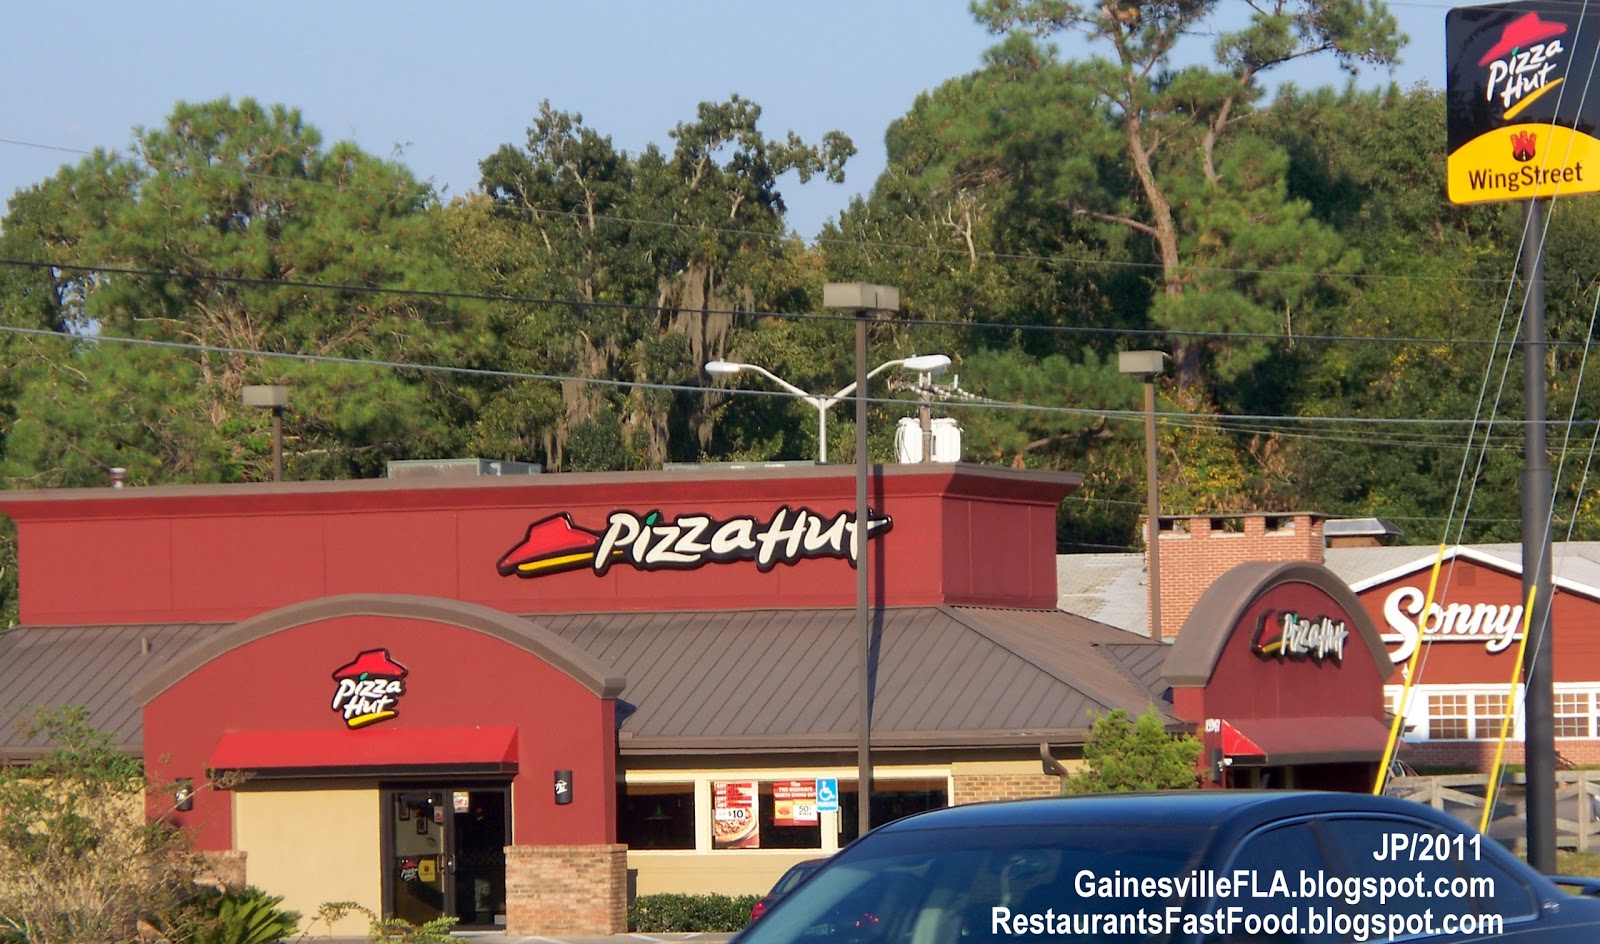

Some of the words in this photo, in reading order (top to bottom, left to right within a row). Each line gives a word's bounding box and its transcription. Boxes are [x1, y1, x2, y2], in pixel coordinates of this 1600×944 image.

[1486, 39, 1564, 102] Pizza
[1500, 62, 1557, 108] Hut
[1468, 162, 1583, 192] WingStreet
[594, 512, 756, 570] Pizza
[756, 508, 888, 565] Hut
[1280, 613, 1320, 656] Pizza
[1318, 617, 1350, 660] Hut
[1384, 586, 1524, 664] Sonny
[332, 672, 402, 710] Pizza
[343, 695, 394, 719] Hut
